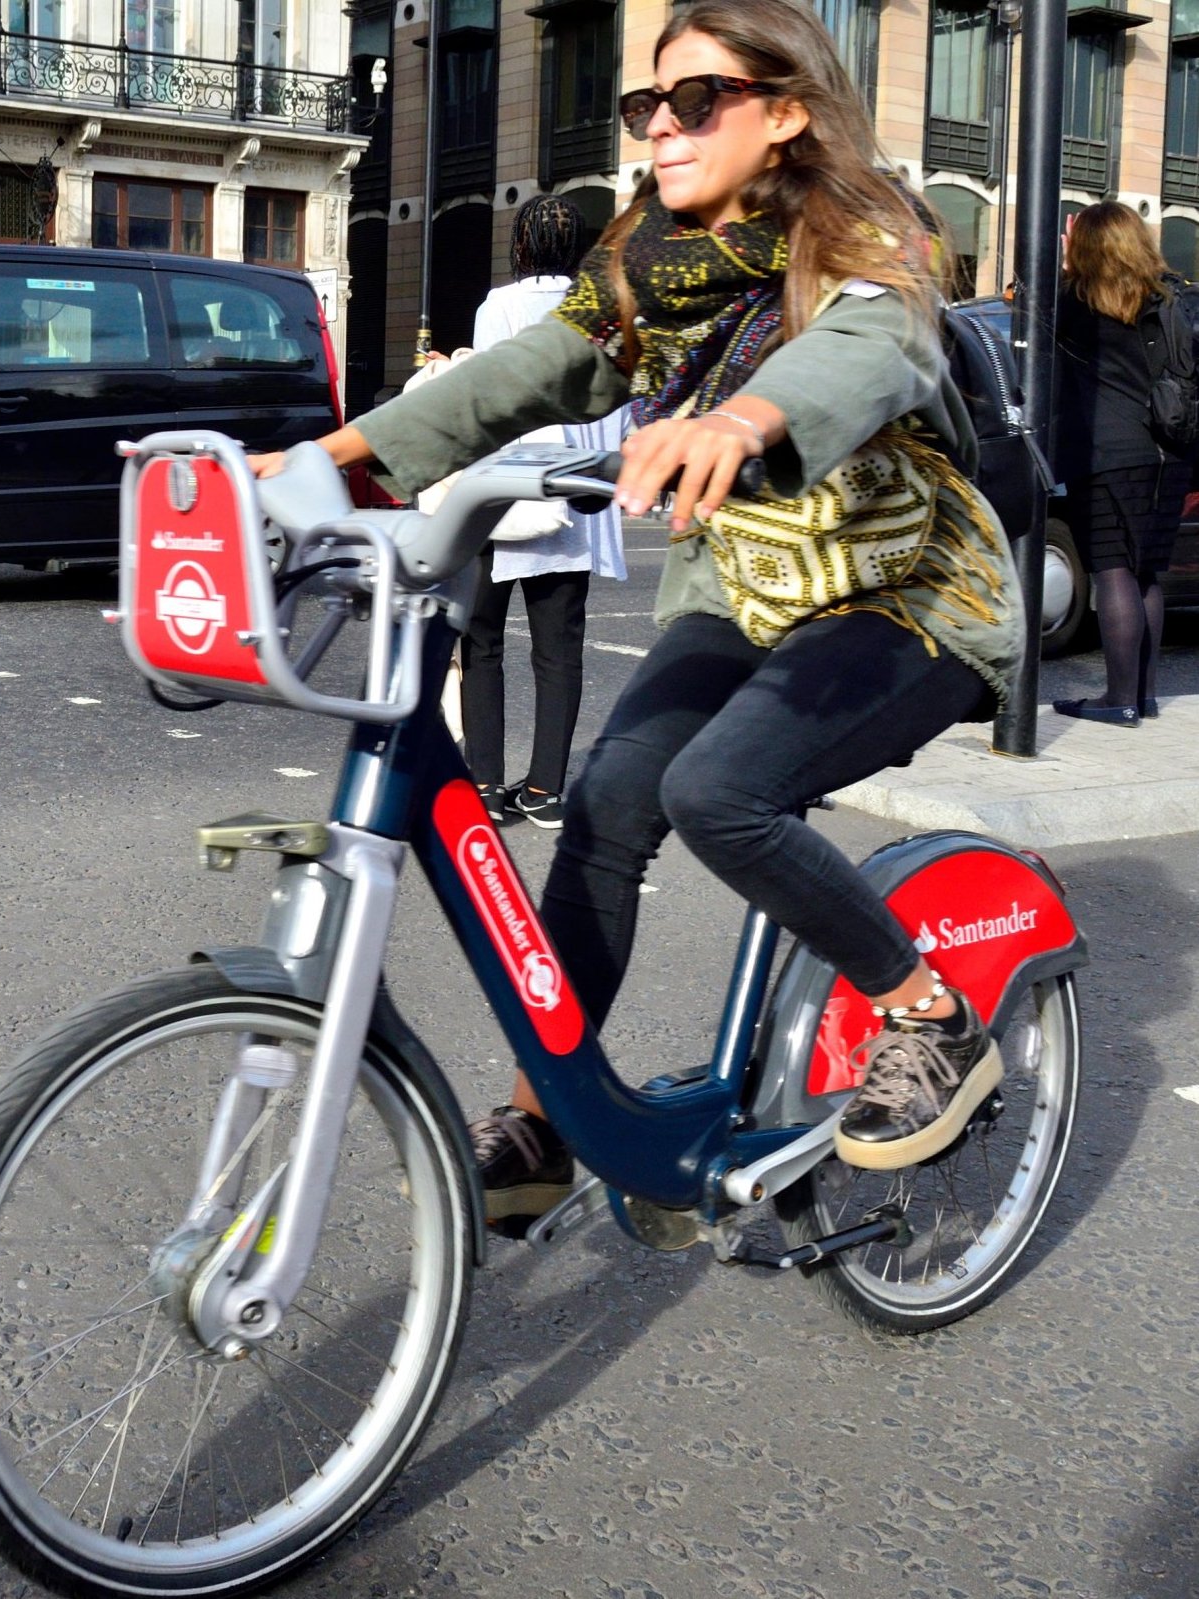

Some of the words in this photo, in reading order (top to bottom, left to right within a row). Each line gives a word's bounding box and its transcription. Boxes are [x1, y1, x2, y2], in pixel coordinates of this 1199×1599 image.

[176, 152, 218, 165] TAVERN
[478, 857, 532, 951] Santander
[938, 901, 1038, 950] Santander
